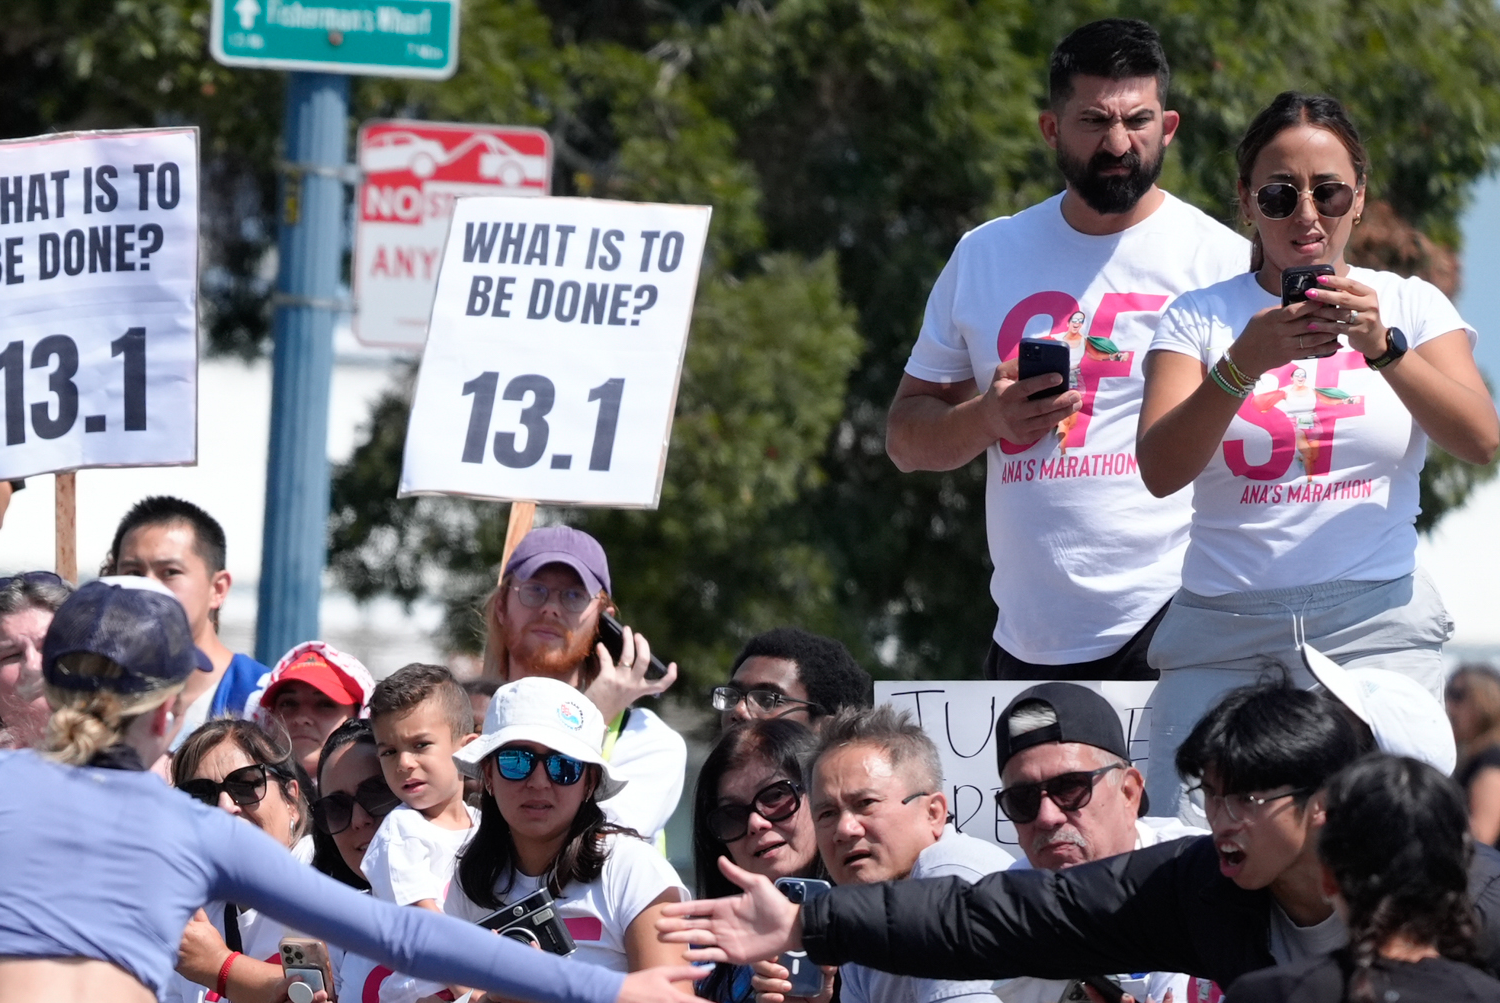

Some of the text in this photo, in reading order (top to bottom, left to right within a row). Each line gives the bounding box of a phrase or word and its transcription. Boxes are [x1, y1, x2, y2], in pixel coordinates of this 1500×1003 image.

[83, 164, 119, 215] IS
[133, 161, 181, 211] TO
[364, 185, 421, 219] NO
[39, 222, 164, 281] DONE?
[369, 244, 439, 280] ANY
[462, 222, 685, 273] WHAT IS TO
[465, 275, 659, 327] BE DONE?
[997, 290, 1169, 455] SF
[461, 371, 626, 472] 13.1
[1223, 350, 1368, 481] SF
[1001, 453, 1137, 485] ANA'S MARATHON
[1240, 478, 1373, 505] ANA'S MARATHON
